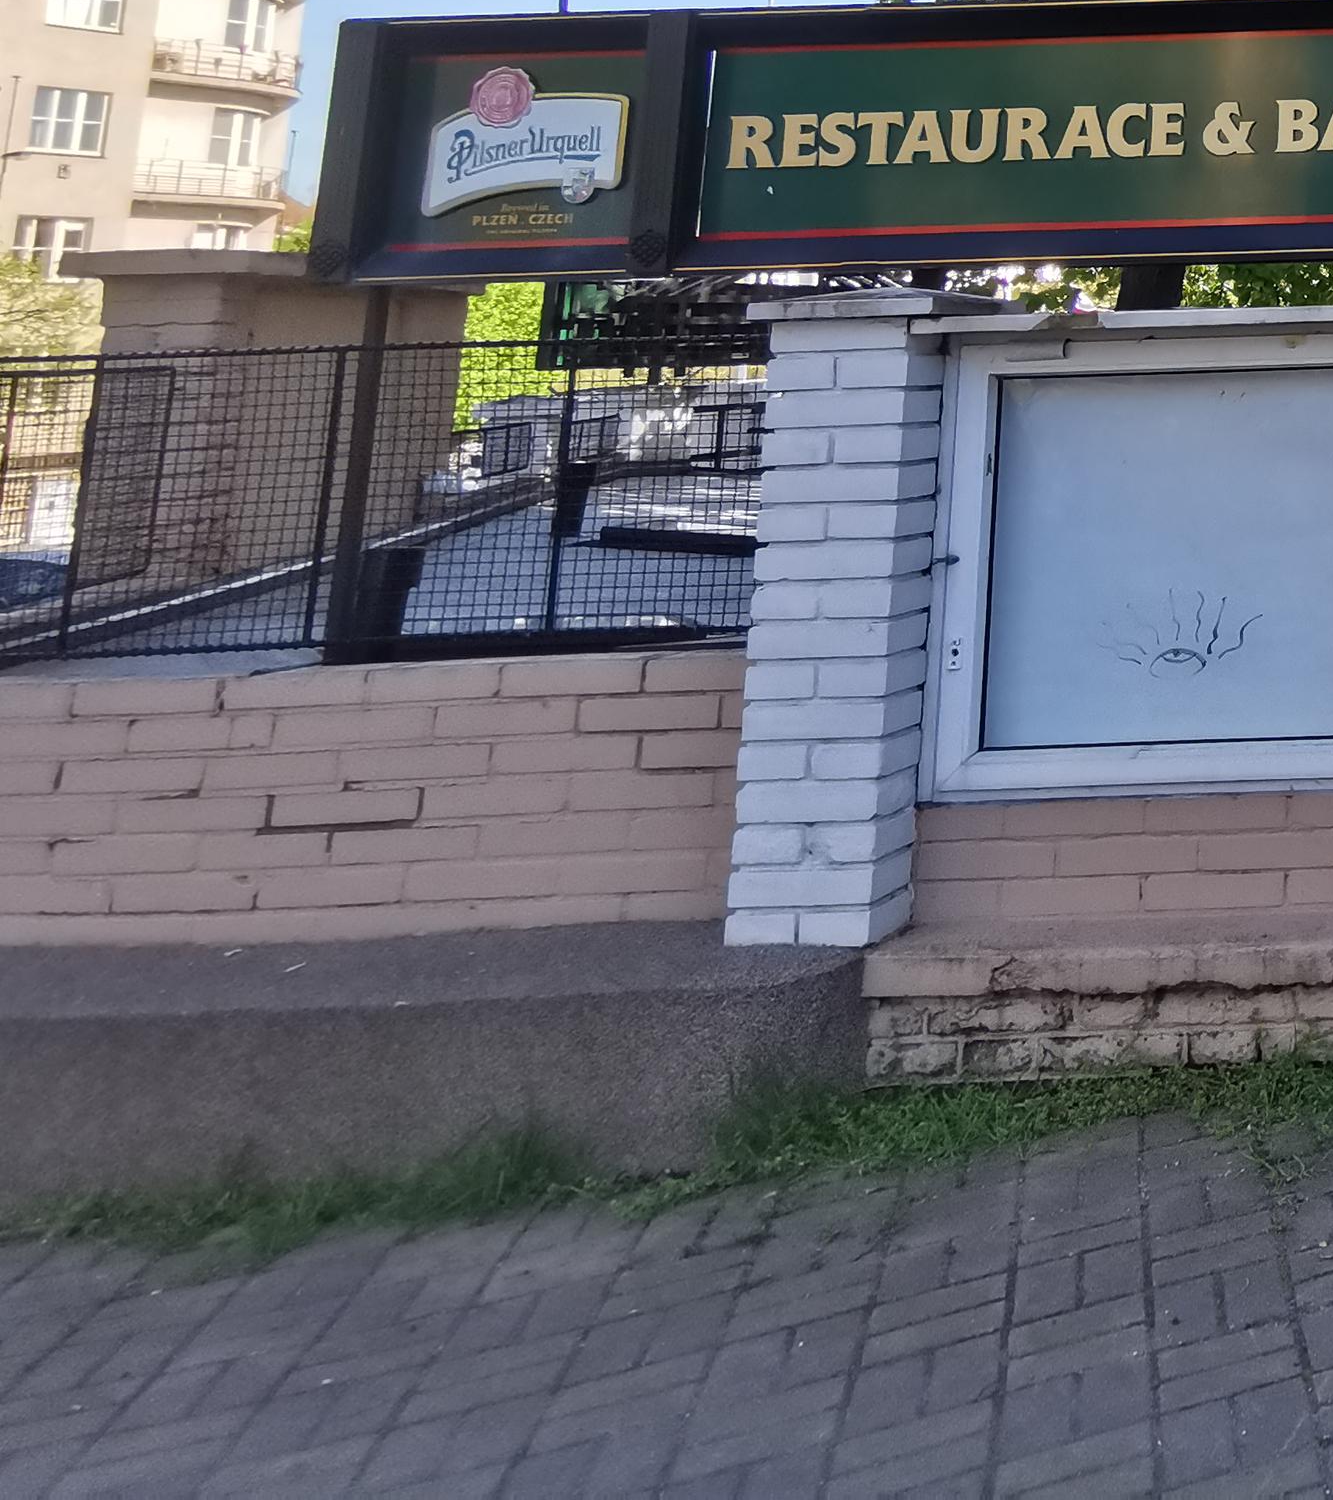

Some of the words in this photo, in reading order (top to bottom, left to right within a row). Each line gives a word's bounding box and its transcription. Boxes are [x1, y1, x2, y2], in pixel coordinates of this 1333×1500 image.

[447, 129, 530, 183] Pilsner
[528, 124, 602, 164] Urquell
[725, 101, 1185, 171] RESTAURACE
[1201, 103, 1255, 156] &
[528, 213, 574, 225] CZECH
